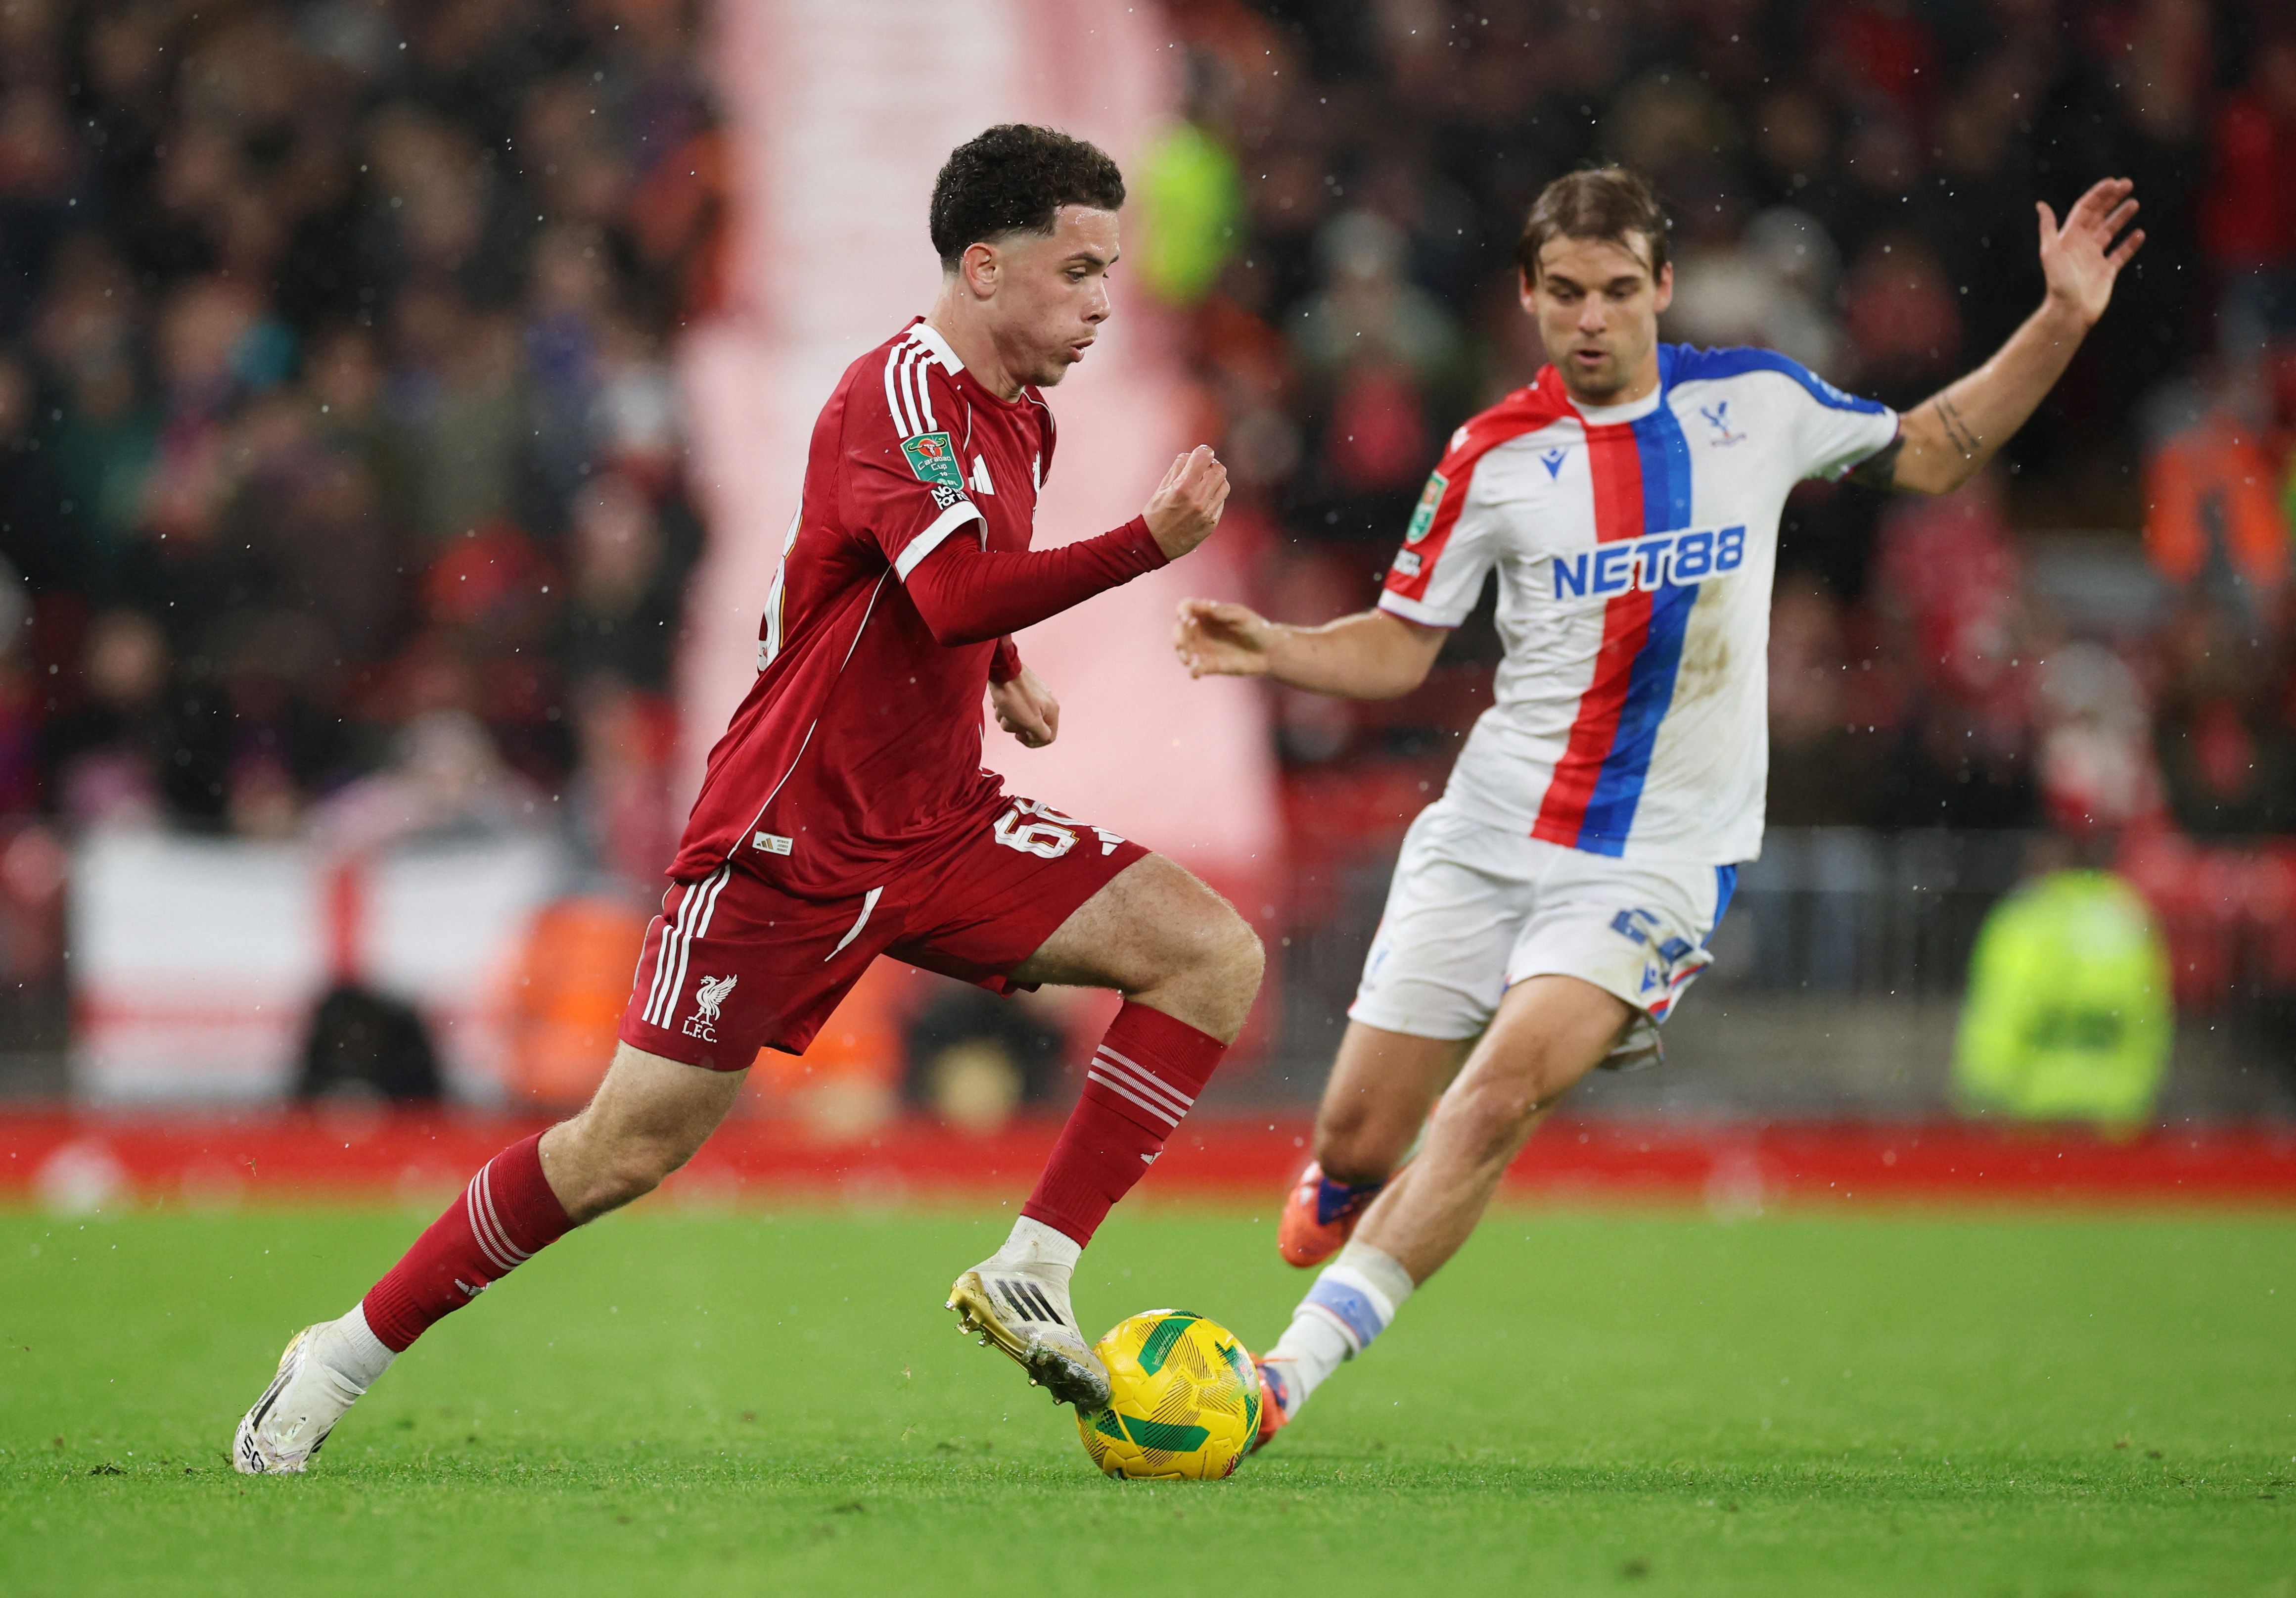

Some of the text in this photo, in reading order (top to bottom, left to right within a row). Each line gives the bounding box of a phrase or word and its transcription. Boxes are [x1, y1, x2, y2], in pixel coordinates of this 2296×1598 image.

[918, 456, 952, 470] Carabao
[931, 486, 953, 497] No
[1553, 525, 1746, 600] NET88
[682, 1020, 717, 1043] L.F.C.
